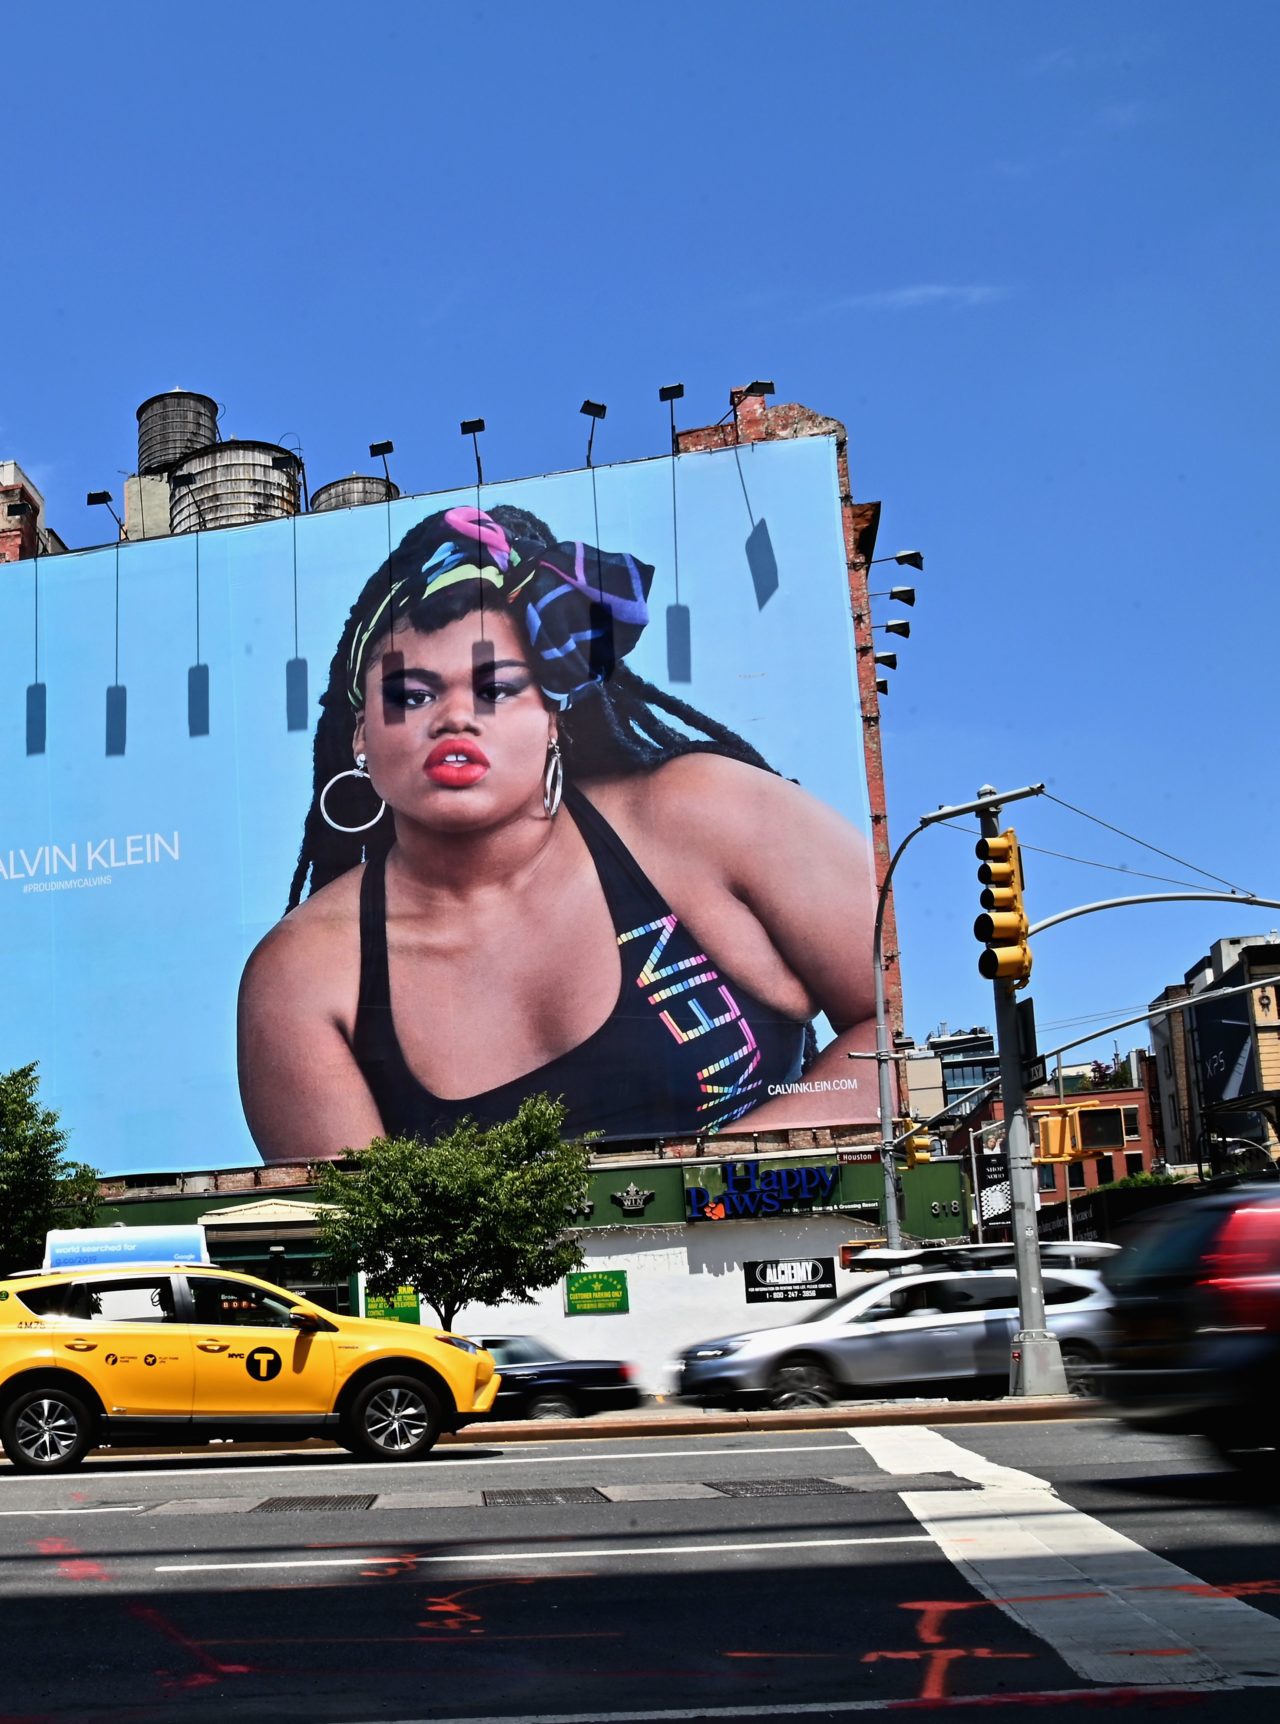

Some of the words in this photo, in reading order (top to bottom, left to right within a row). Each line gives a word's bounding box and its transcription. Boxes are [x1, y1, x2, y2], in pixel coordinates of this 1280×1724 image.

[87, 830, 180, 871] KLEIN
[23, 875, 112, 893] #PROUDINMYCALVINS
[767, 1078, 858, 1096] CALVINKLEIN.COM
[843, 1153, 872, 1161] Houston
[722, 1161, 839, 1200] Happy
[622, 1198, 644, 1207] WIN
[931, 1200, 960, 1215] 318
[55, 1245, 79, 1253] world
[123, 1243, 136, 1251] for
[173, 1253, 196, 1261] Google
[766, 1262, 813, 1284] ALCHEMY
